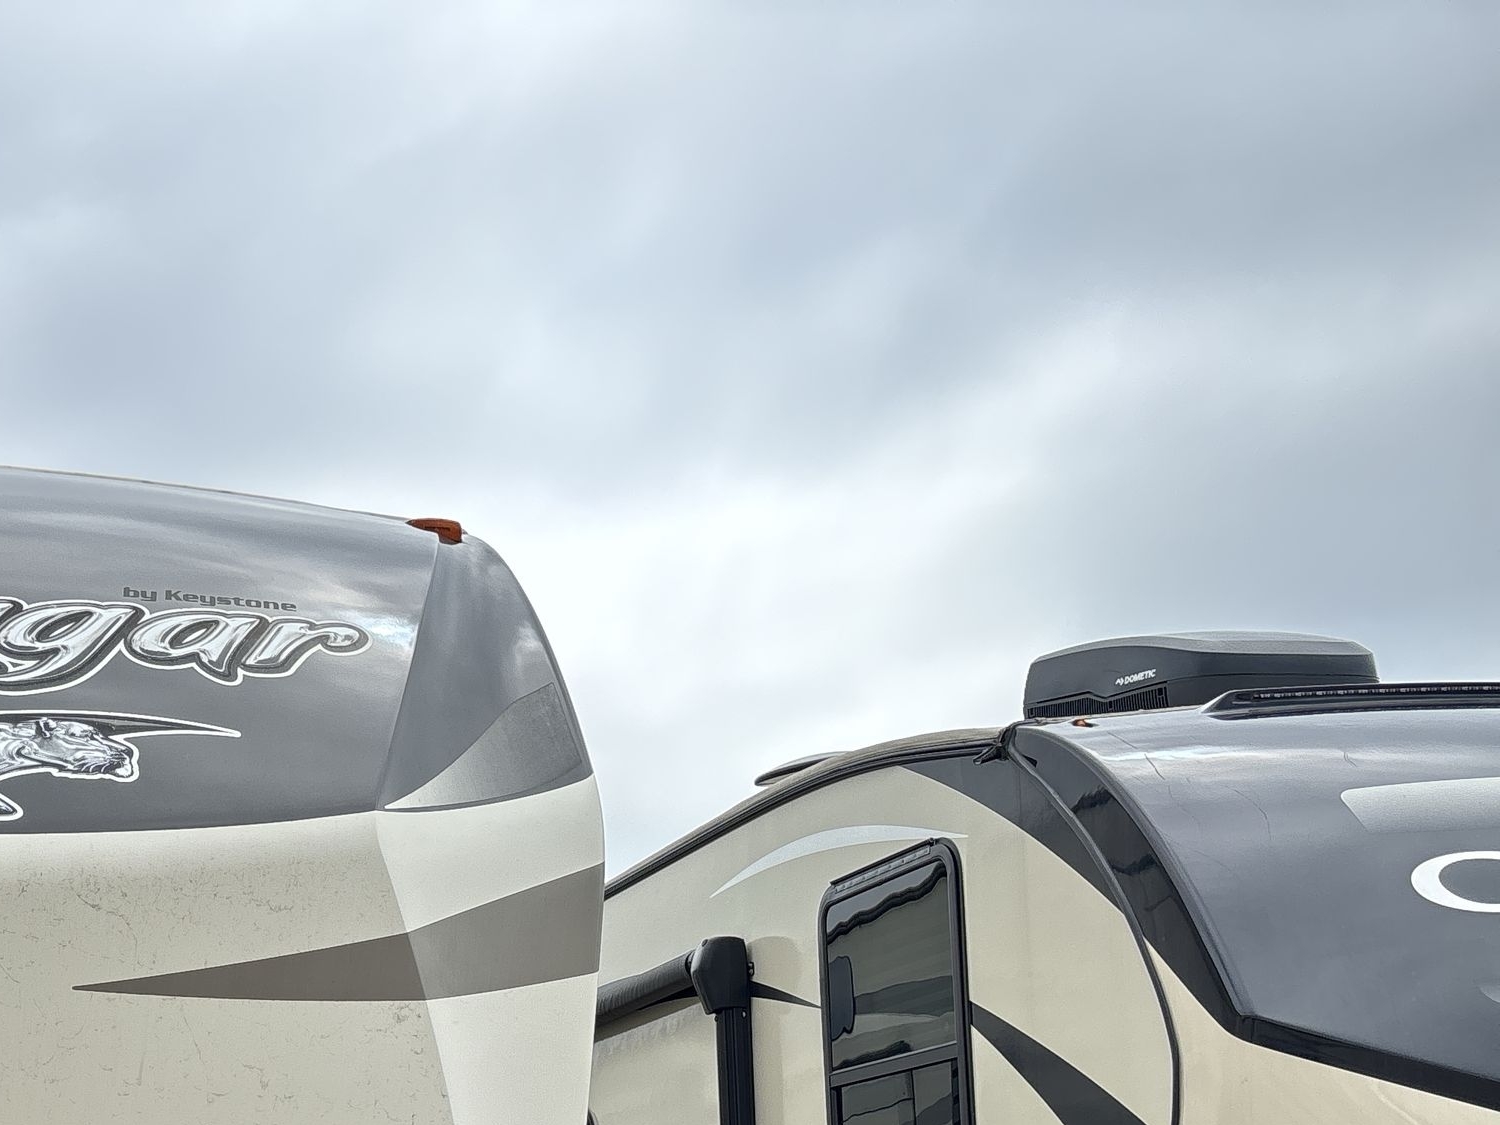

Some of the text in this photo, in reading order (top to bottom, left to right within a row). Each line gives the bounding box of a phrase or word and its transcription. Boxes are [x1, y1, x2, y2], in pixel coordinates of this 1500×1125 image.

[123, 587, 297, 612] by Keystone
[1124, 668, 1156, 684] DOMETIC
